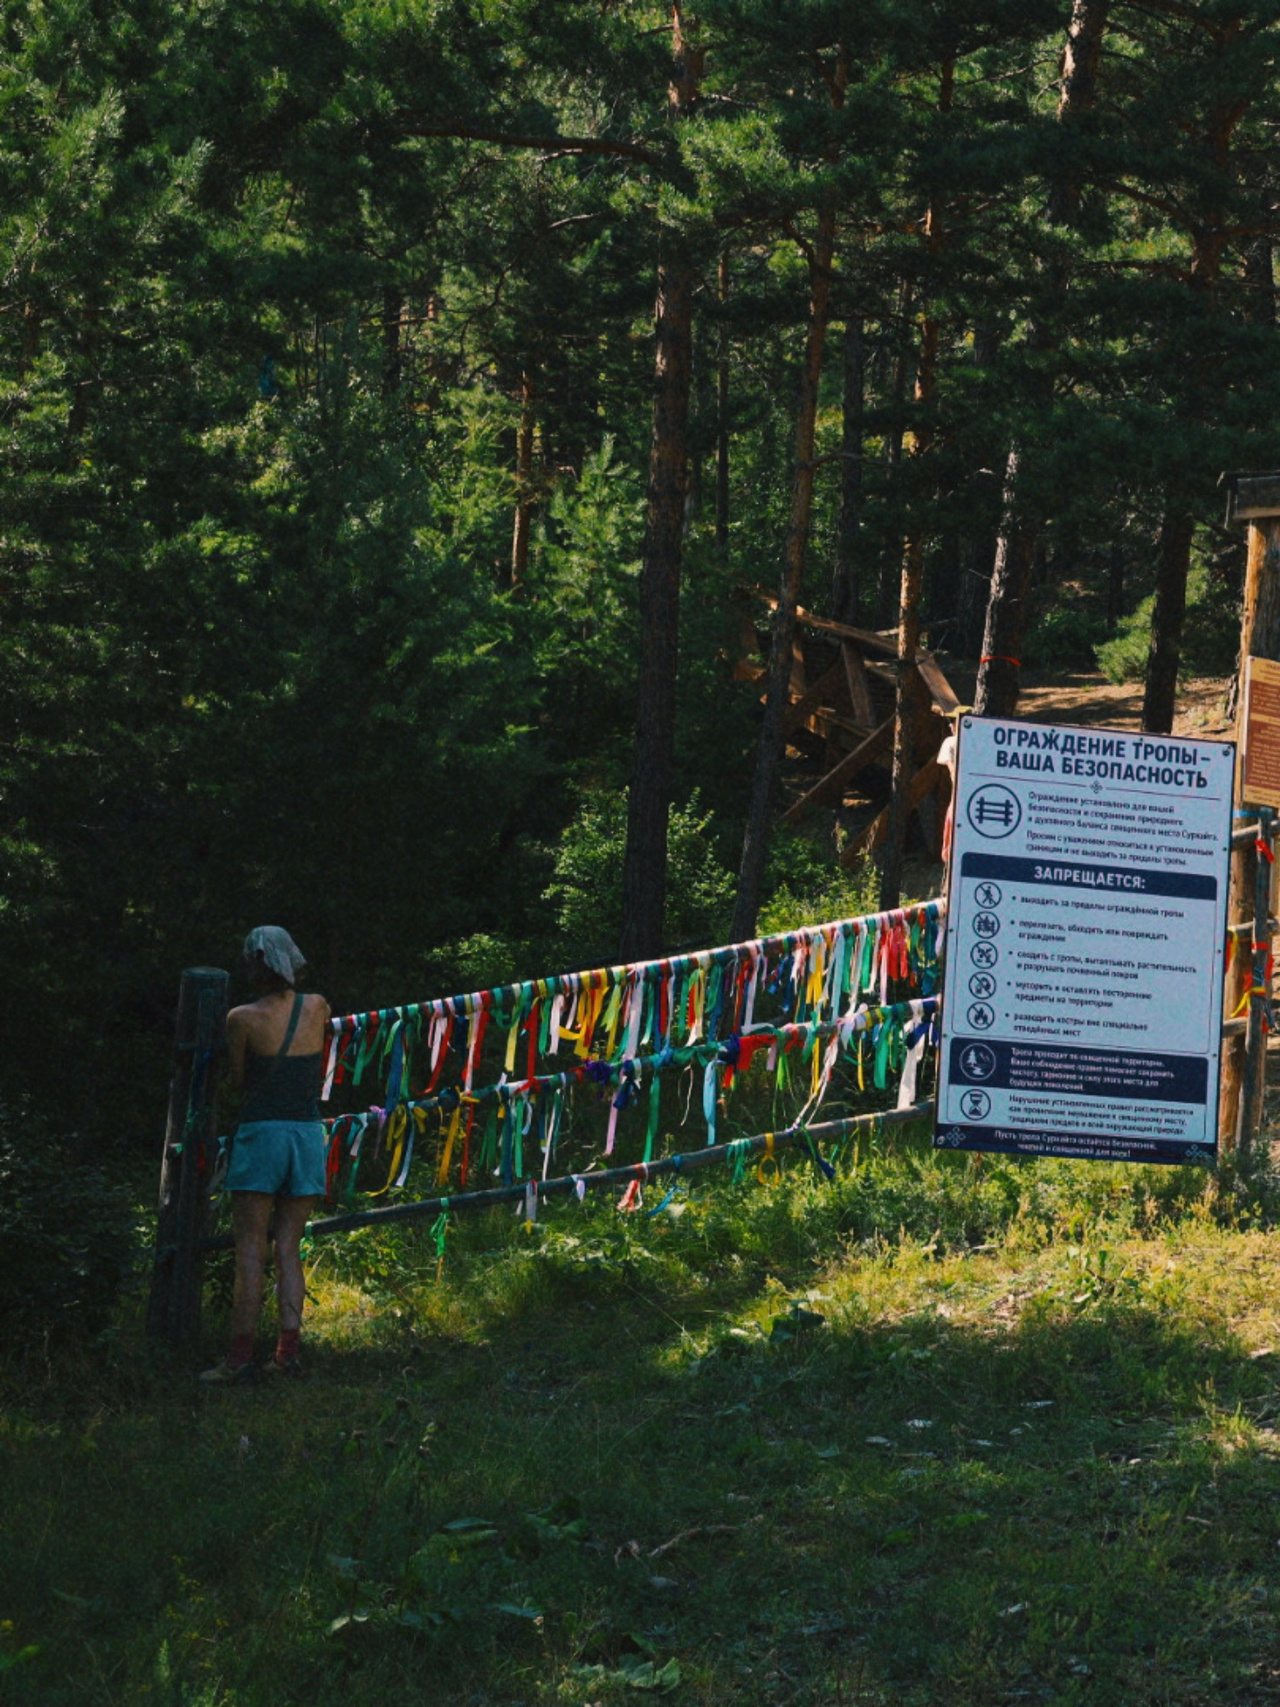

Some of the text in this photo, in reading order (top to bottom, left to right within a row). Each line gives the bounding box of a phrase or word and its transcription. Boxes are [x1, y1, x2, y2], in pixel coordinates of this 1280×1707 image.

[992, 726, 1126, 760] ОГРАЖДЕНИЕ
[1131, 741, 1197, 765] ТРОПЫ
[995, 749, 1208, 789] ВАША БЕЗОПАСНОСТЬ
[1034, 865, 1145, 889] ЗАПРЕЩАЕТСЯ:
